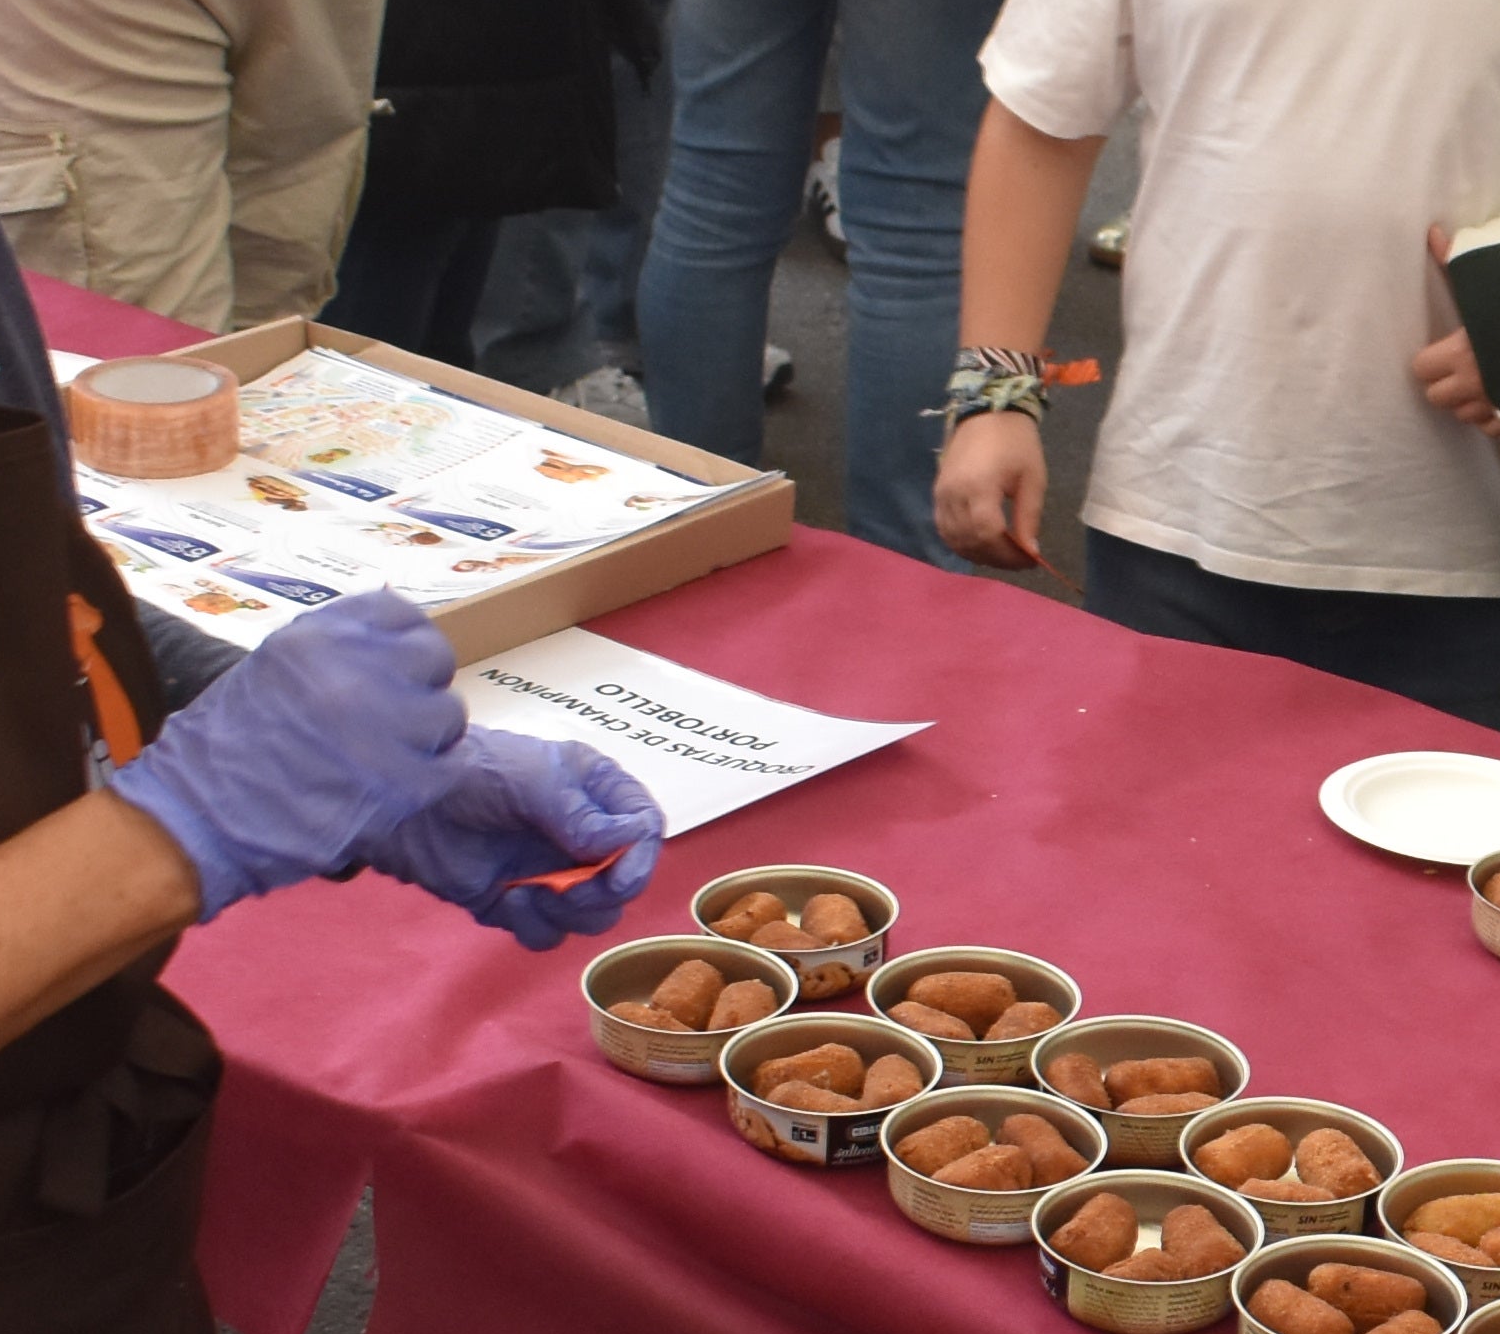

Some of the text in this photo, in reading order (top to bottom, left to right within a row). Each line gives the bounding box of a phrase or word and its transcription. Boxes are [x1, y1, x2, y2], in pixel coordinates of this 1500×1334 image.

[478, 667, 815, 776] CROQUETAS DE CHAMPIÑÓN
[595, 683, 780, 751] PORTOBELLO
[1297, 1215, 1318, 1224] SIN
